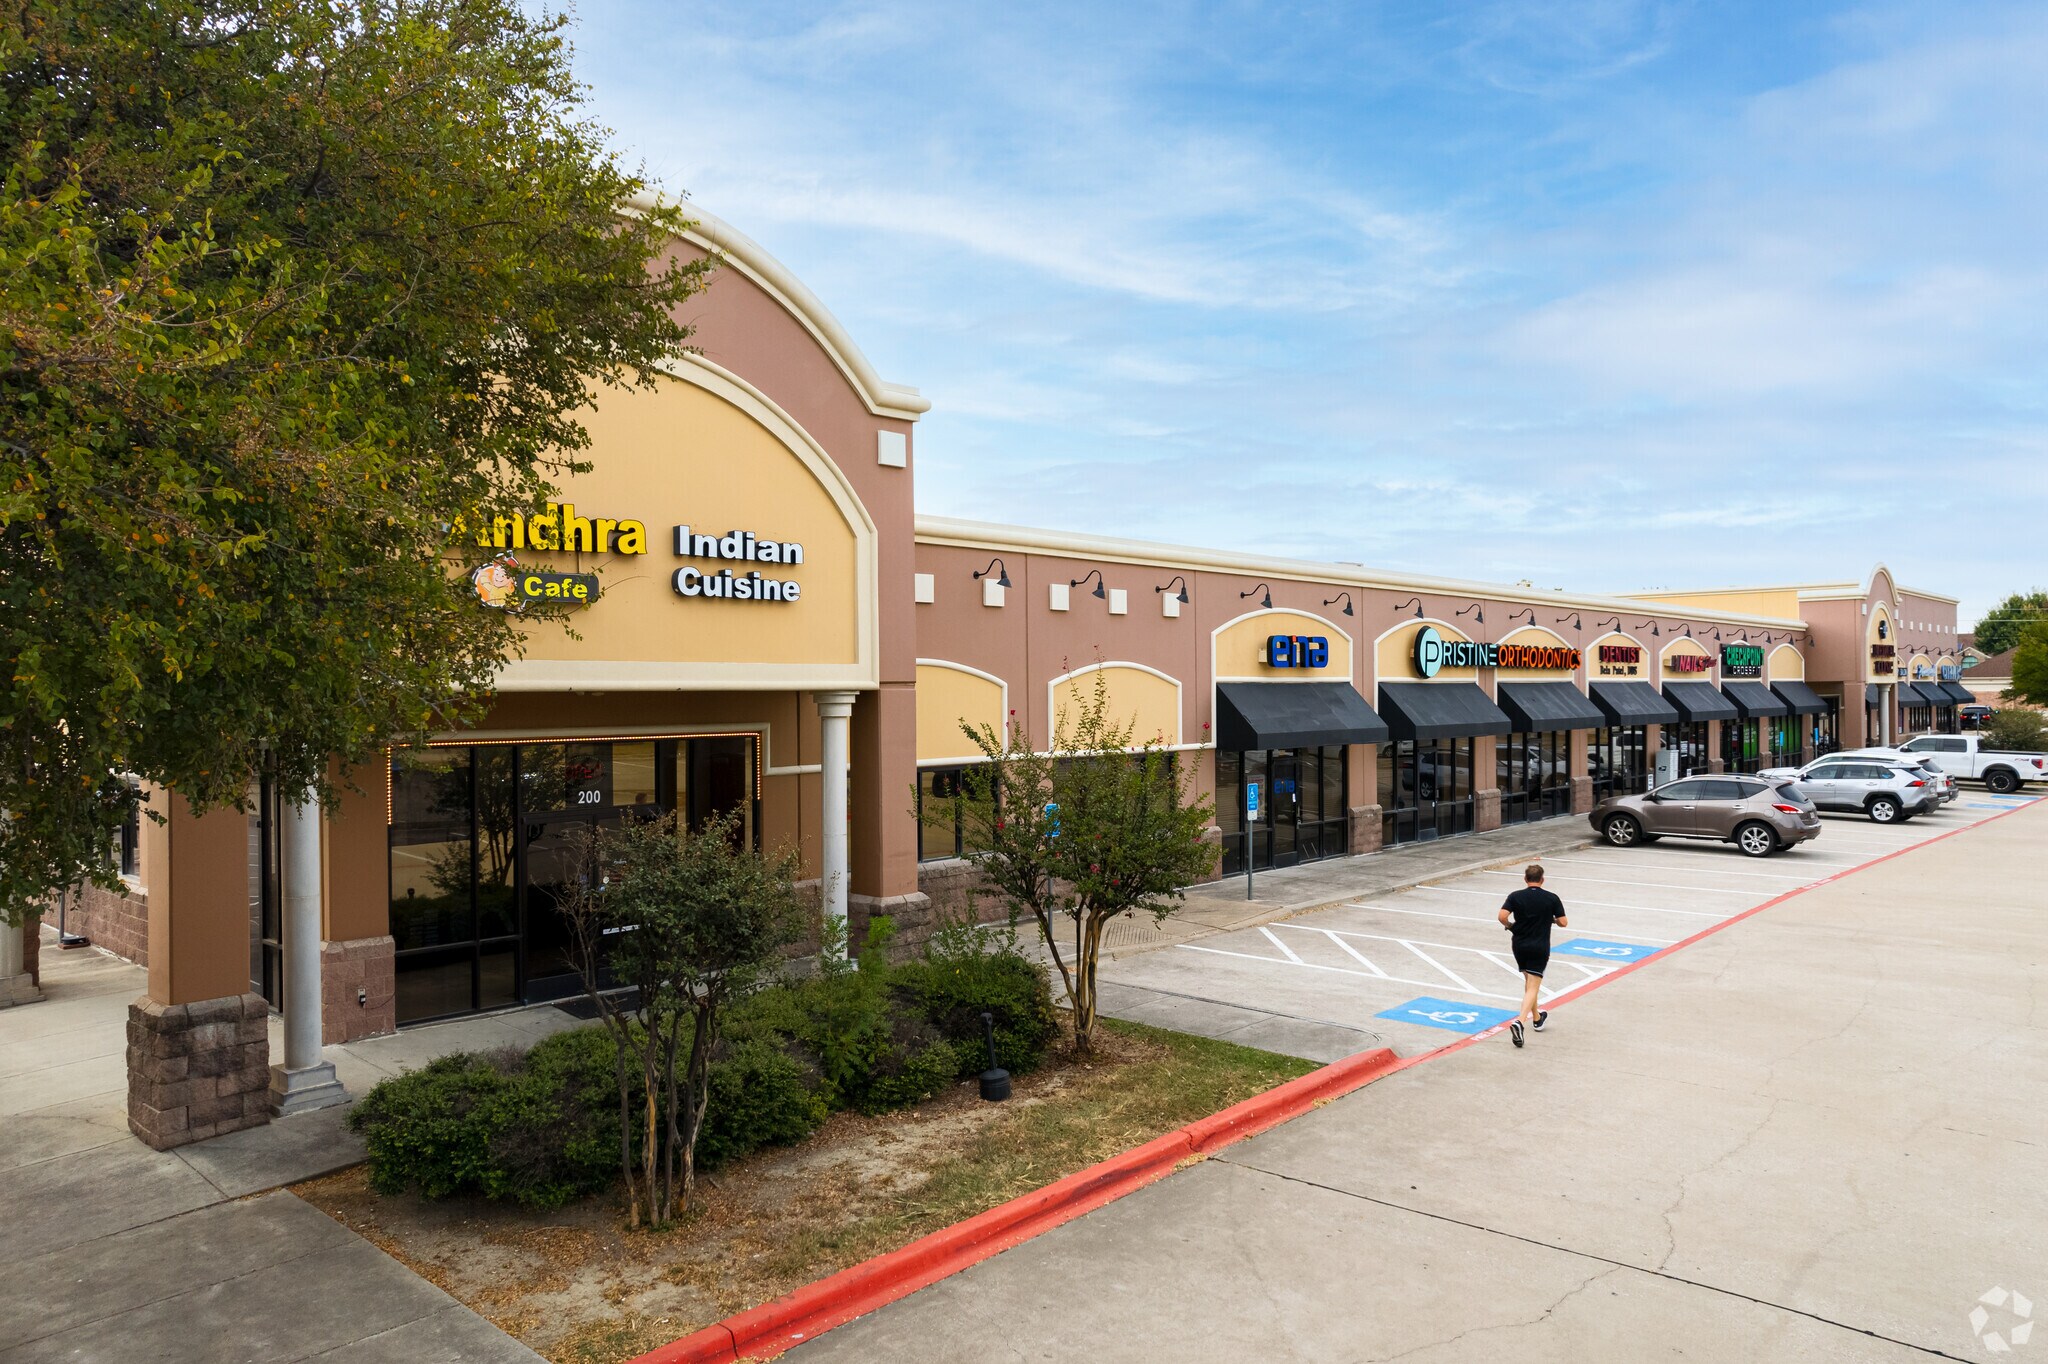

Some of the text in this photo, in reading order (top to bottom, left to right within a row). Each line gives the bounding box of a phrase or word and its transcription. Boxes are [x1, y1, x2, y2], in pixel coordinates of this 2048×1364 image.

[674, 524, 804, 565] Indian
[523, 576, 589, 599] Cafe
[673, 565, 802, 603] Cuisine
[1422, 637, 1582, 675] PRISTINE ORTHODONTICS
[1599, 646, 1641, 663] DENTIST
[1726, 647, 1765, 667] CHECKPOINT
[1733, 666, 1761, 675] CROSSFIT
[578, 791, 601, 804] 200
